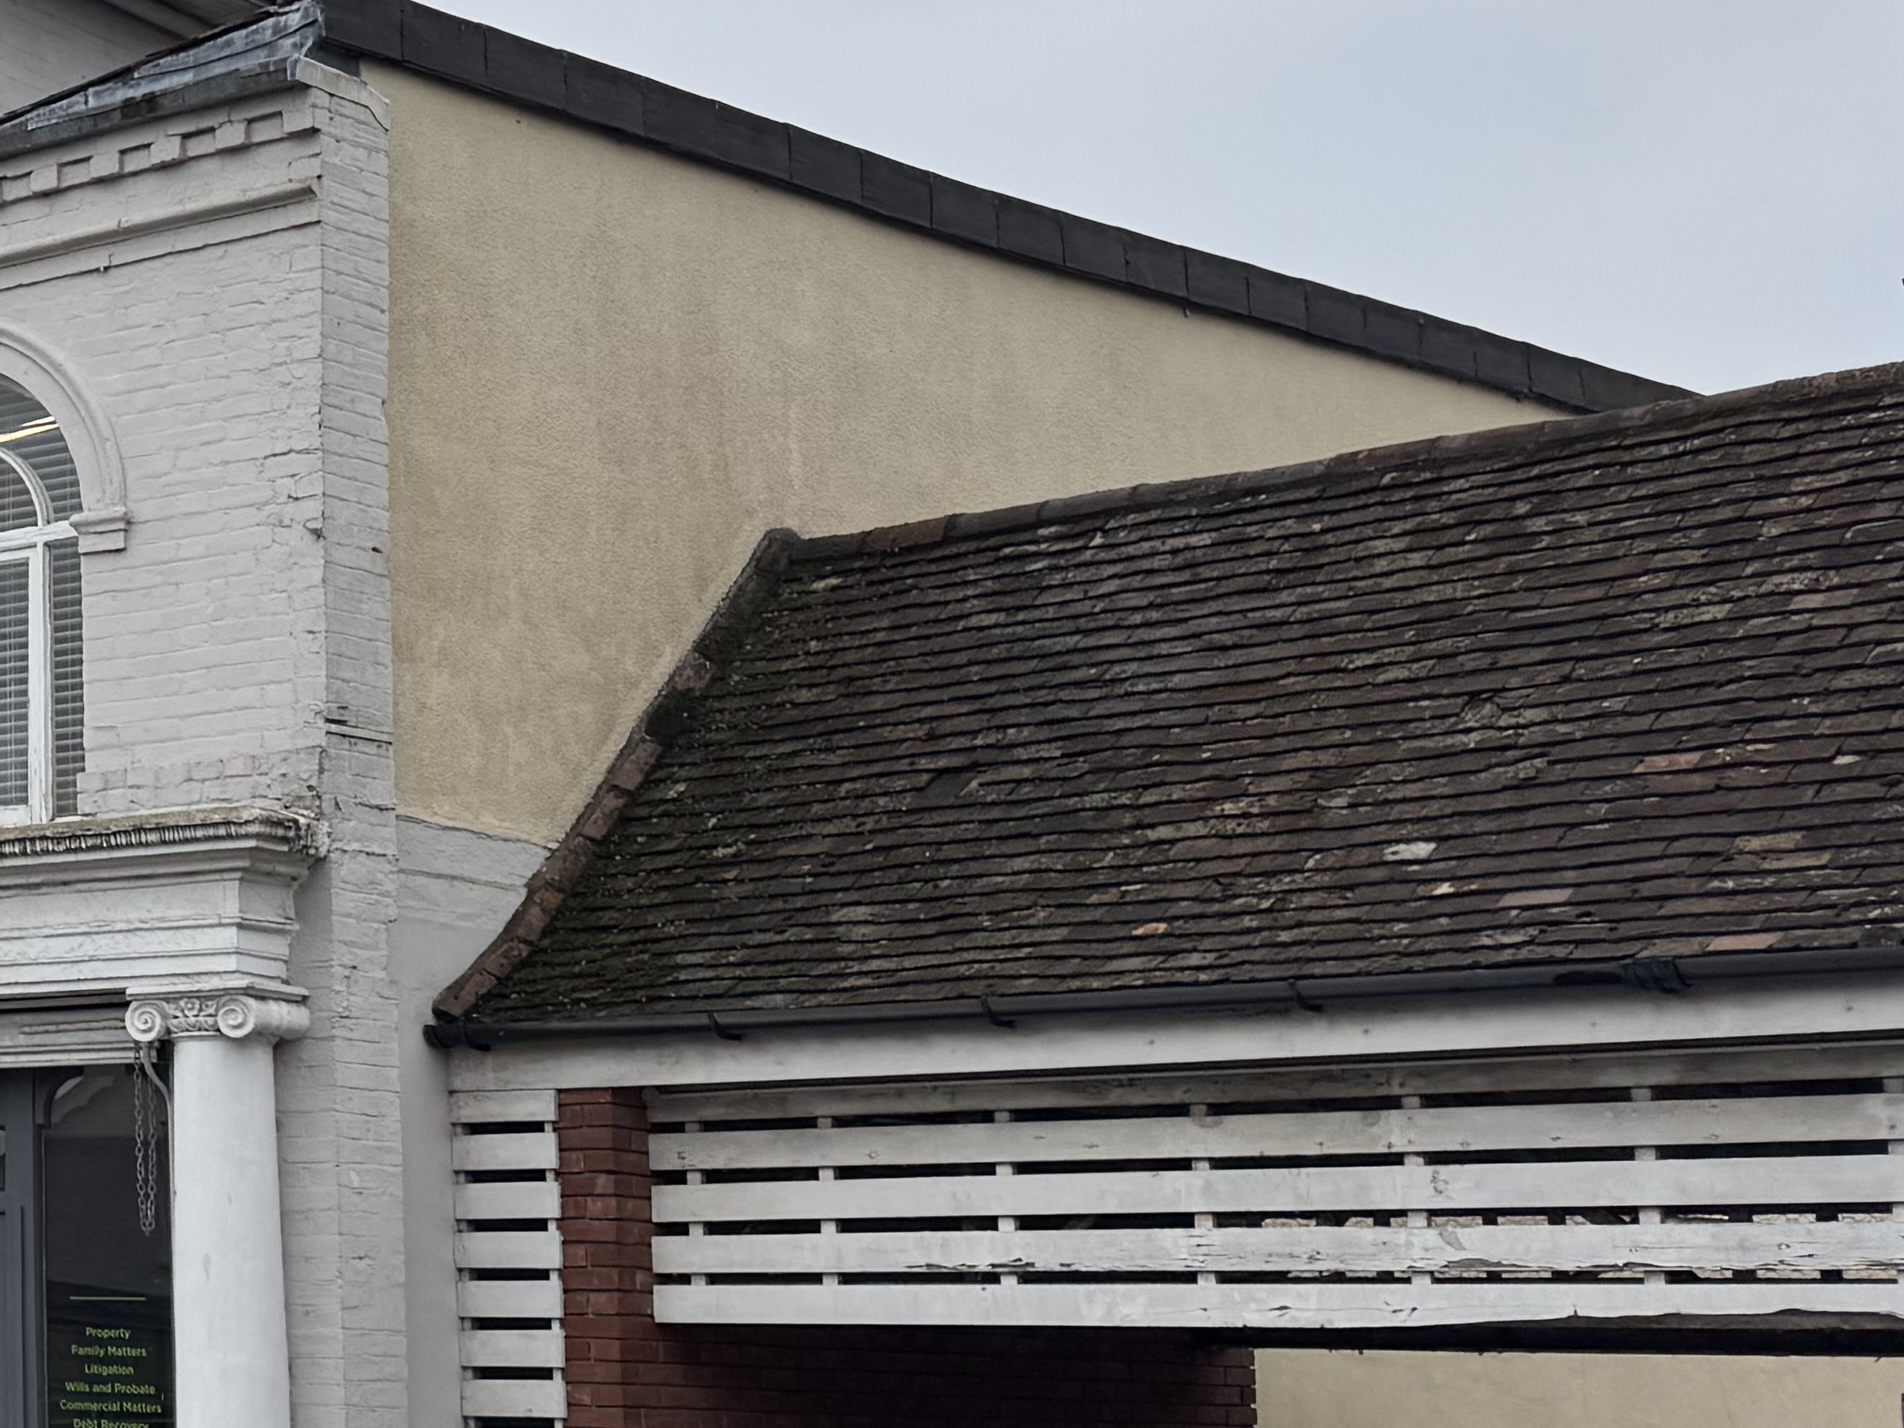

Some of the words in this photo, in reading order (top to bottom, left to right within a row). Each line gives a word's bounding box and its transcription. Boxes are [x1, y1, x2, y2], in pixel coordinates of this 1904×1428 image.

[85, 1326, 132, 1340] Property
[71, 1344, 104, 1358] Family
[107, 1345, 147, 1357] Matters
[84, 1363, 135, 1376] Litigation
[65, 1382, 90, 1393] Wills
[92, 1382, 112, 1393] and
[114, 1383, 156, 1395] Probate
[59, 1399, 121, 1412] Commercial
[123, 1402, 162, 1413] Matters
